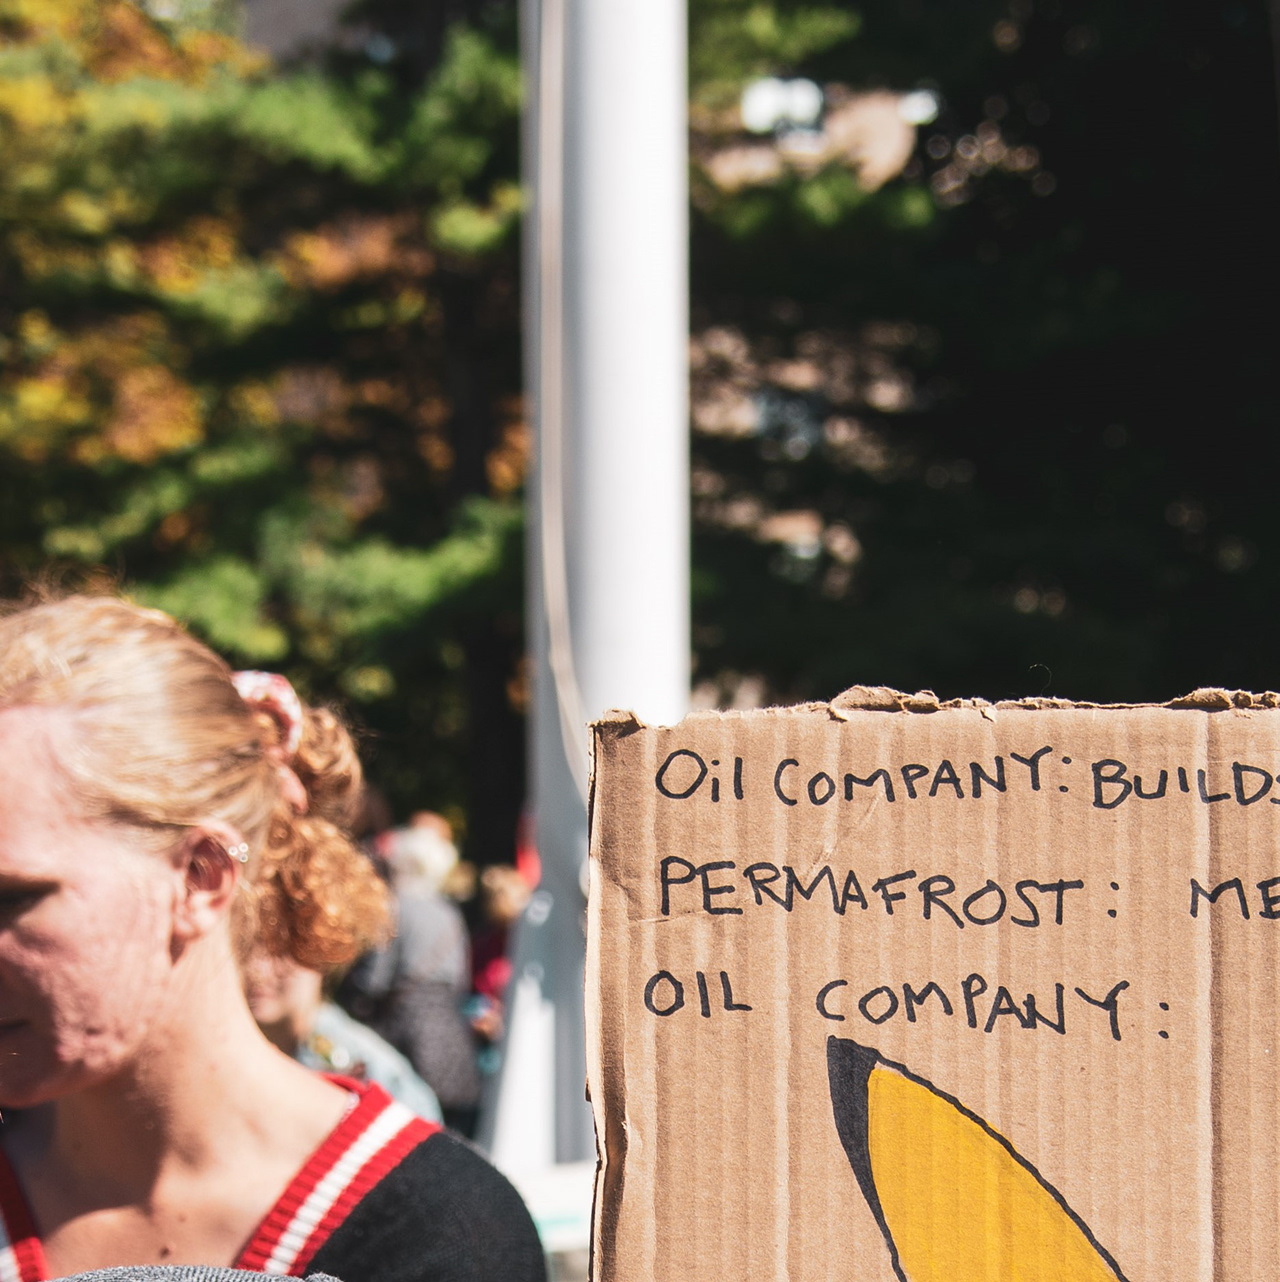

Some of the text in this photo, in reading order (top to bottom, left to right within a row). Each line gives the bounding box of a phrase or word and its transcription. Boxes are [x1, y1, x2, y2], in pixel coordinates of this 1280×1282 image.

[774, 745, 1072, 806] COMPANY:
[660, 855, 1120, 929] PERMAFROST:
[644, 969, 1169, 1040] OIL COMPANY:
